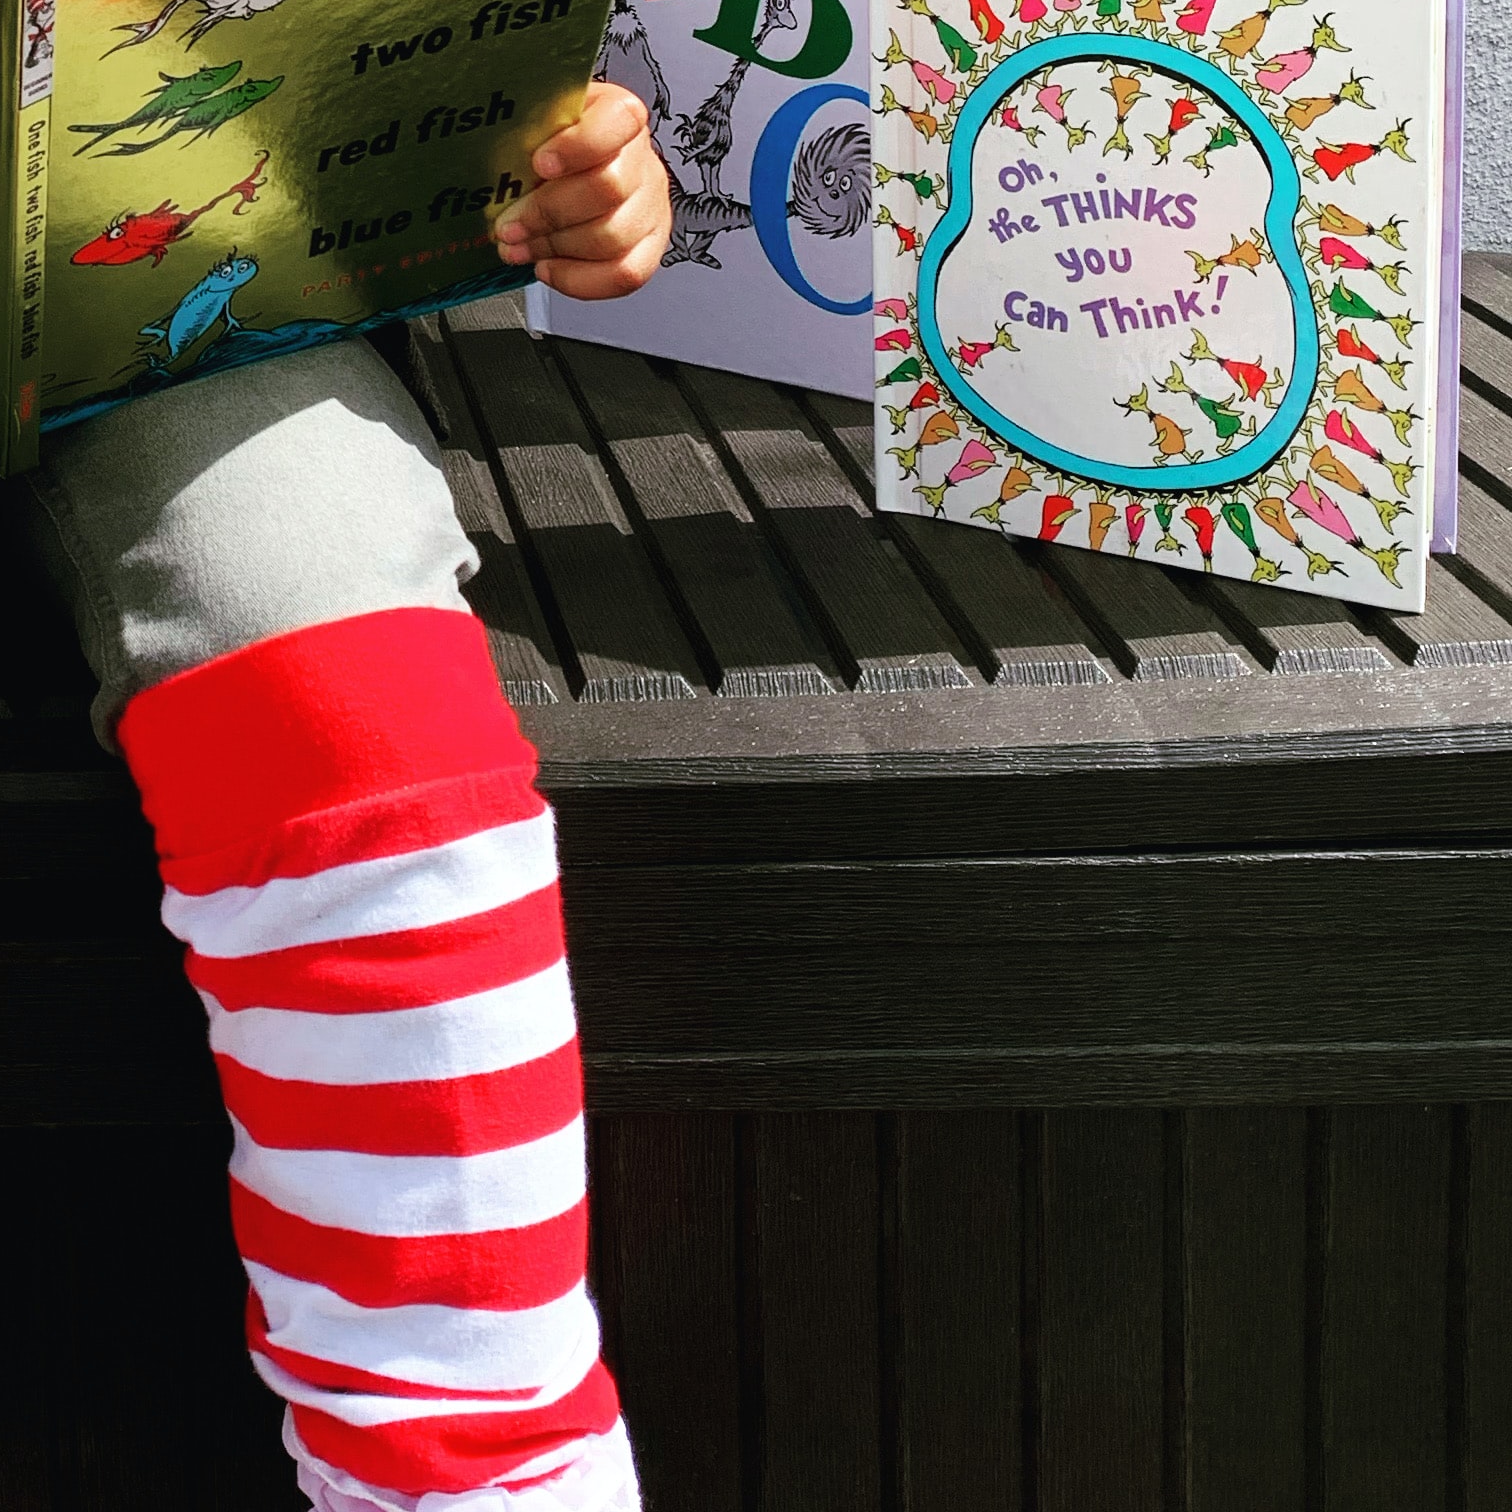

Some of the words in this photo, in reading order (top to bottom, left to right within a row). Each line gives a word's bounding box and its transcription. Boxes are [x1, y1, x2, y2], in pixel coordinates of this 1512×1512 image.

[348, 27, 453, 77] two
[28, 119, 46, 151] One
[314, 118, 406, 174] red
[414, 89, 518, 144] fish
[27, 150, 46, 182] fish
[998, 158, 1058, 193] Oh,
[25, 184, 43, 215] two
[307, 209, 414, 259] blue
[427, 171, 524, 223] fish
[750, 82, 874, 315] C
[24, 214, 44, 246] fish
[987, 207, 1041, 244] the
[23, 248, 42, 274] red
[1054, 246, 1133, 283] you
[1003, 290, 1068, 333] Can
[1079, 275, 1229, 339] Think!
